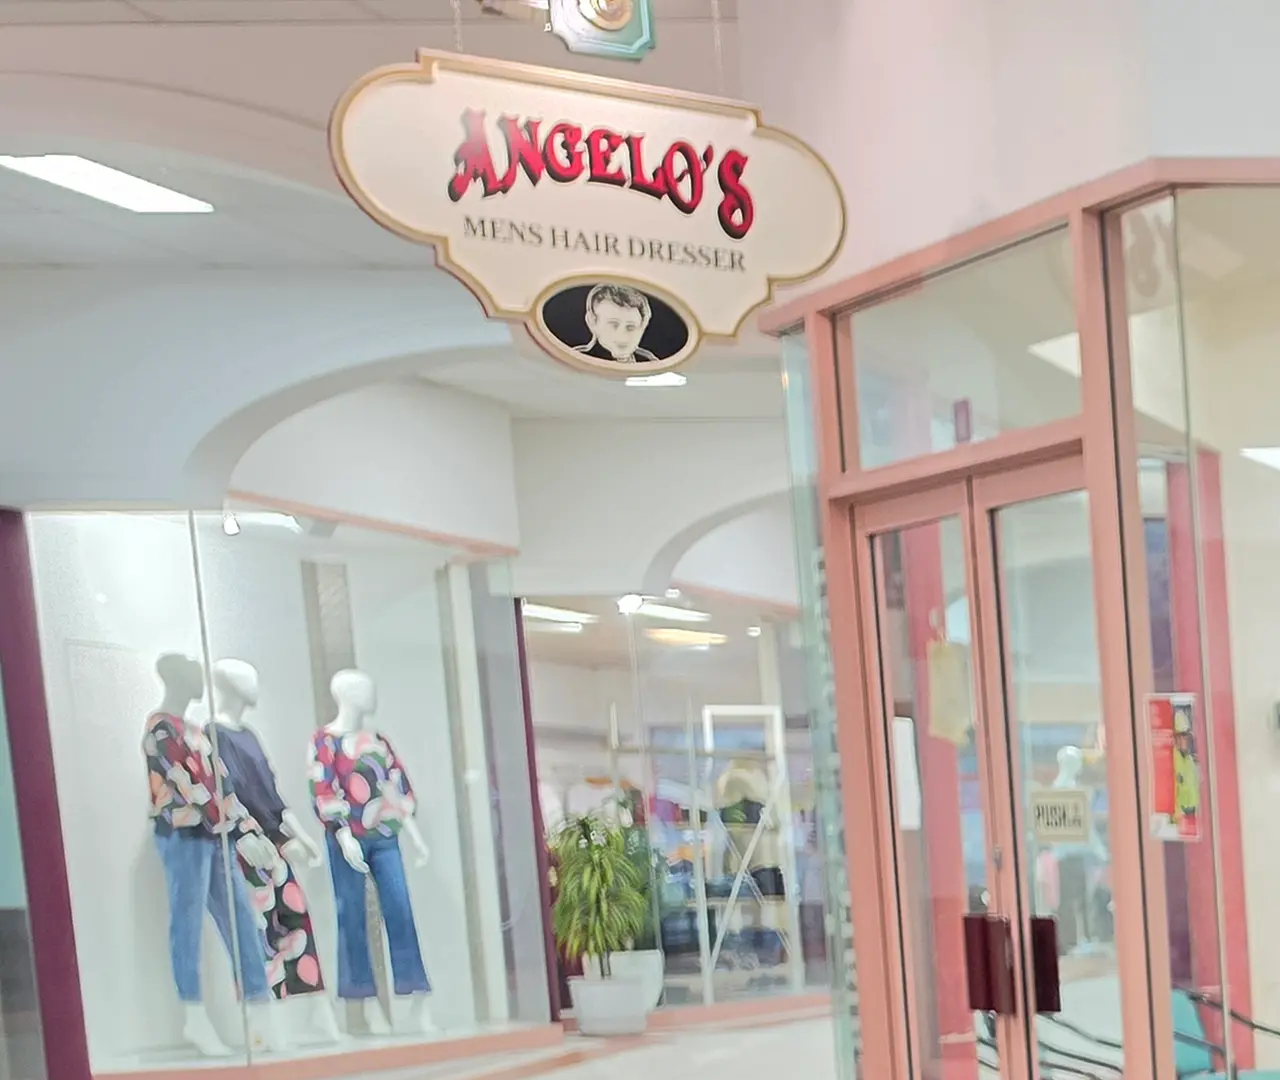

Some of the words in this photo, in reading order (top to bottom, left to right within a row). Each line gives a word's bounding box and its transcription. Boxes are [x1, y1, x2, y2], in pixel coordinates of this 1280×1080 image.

[448, 109, 753, 238] ANGELO'S
[464, 215, 543, 246] MENS
[551, 226, 620, 256] HAIR
[629, 237, 747, 272] DRESSER
